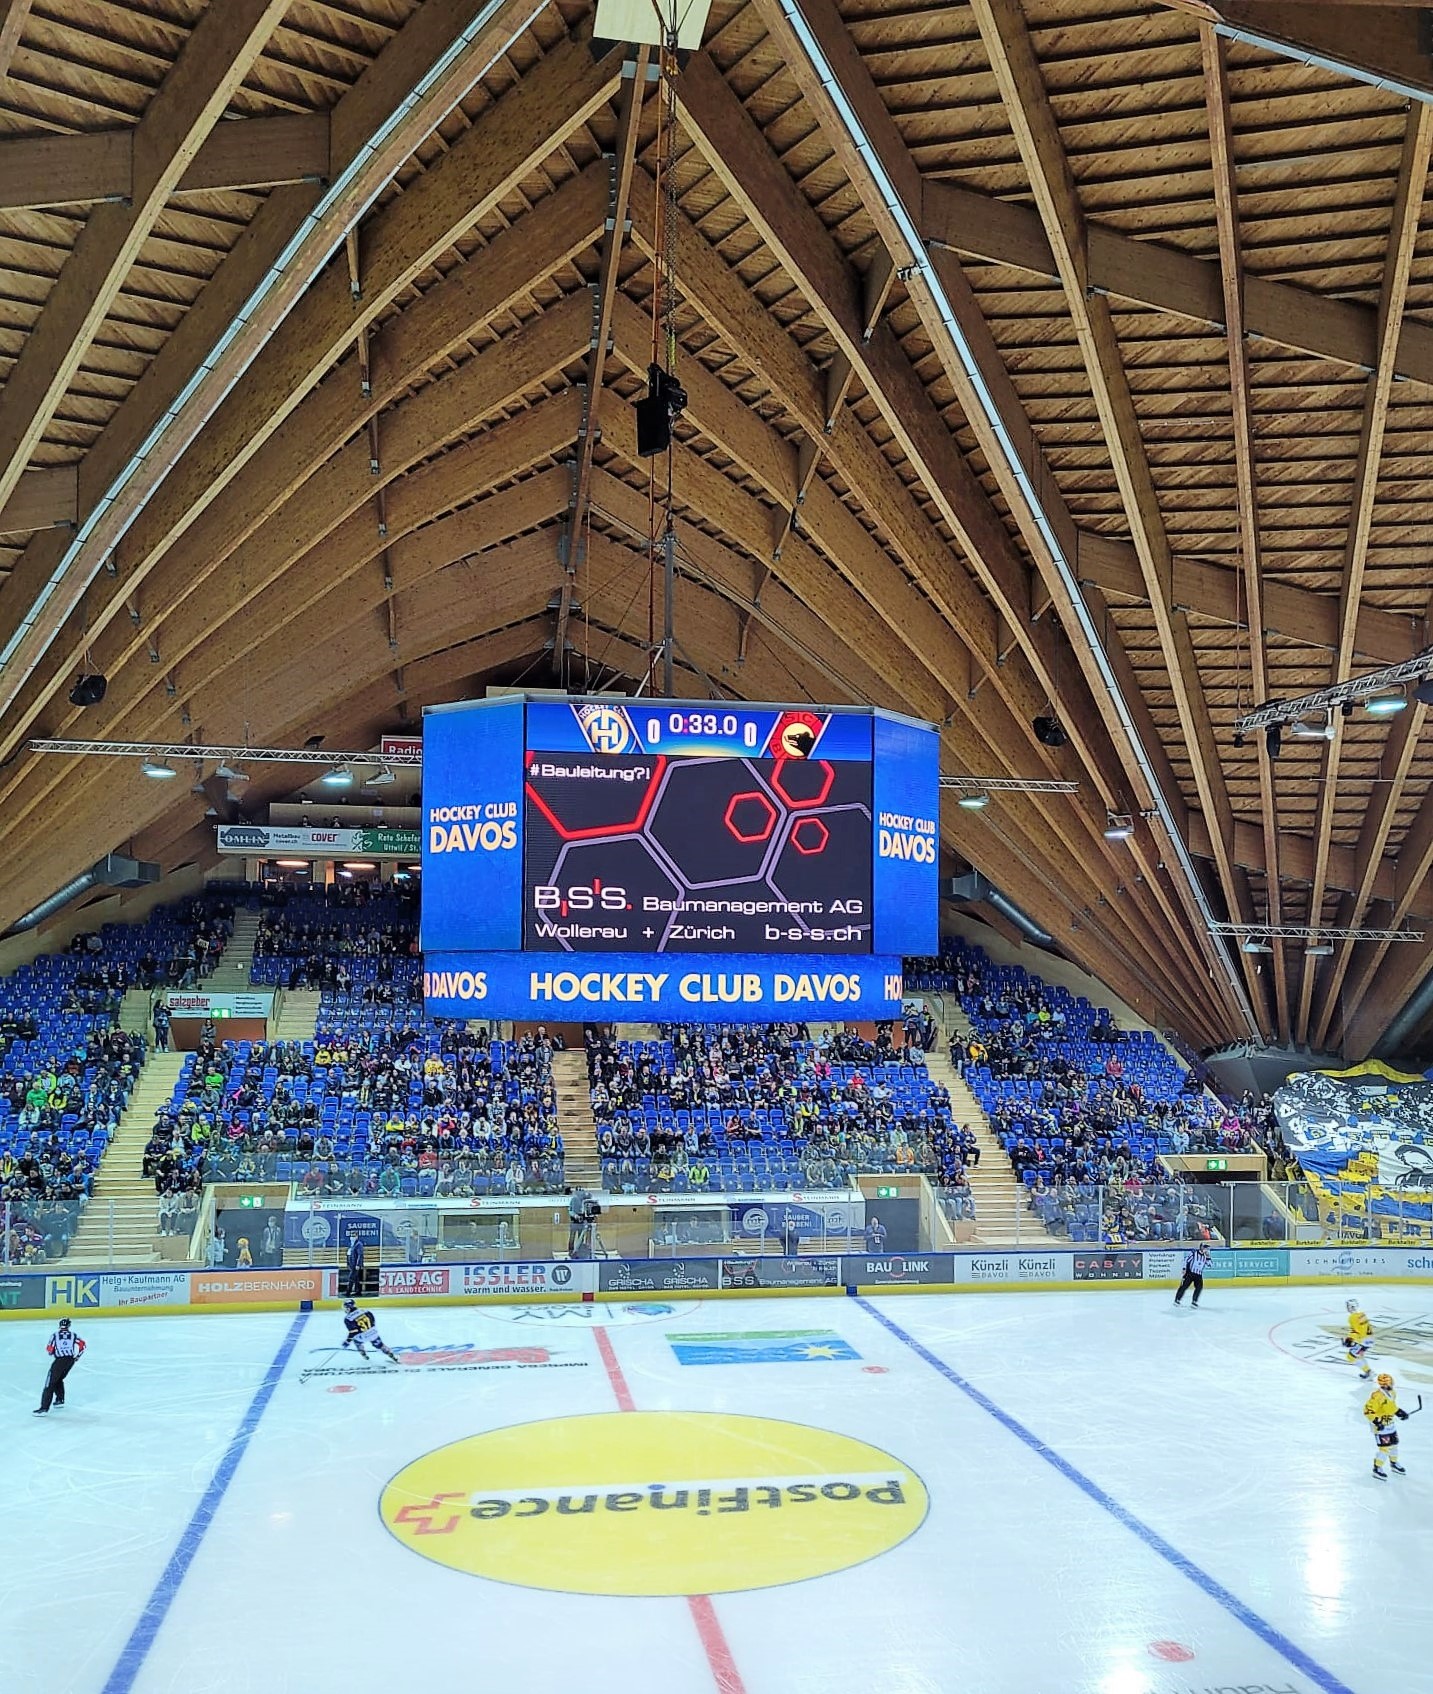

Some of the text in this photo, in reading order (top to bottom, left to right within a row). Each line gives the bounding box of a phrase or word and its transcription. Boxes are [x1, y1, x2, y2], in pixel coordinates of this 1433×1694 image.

[647, 718, 660, 743] 0
[668, 713, 738, 736] 0:33.0
[743, 721, 757, 747] 0
[430, 802, 517, 822] HOCKEY CLUB
[879, 811, 935, 834] HOCKEY CLUB
[430, 820, 518, 854] DAVOS
[879, 830, 935, 863] DAVOS
[643, 897, 863, 916] Baumanagement AG
[534, 923, 862, 941] Wollerau + Zürich b-s-s.ch
[432, 971, 487, 1000] DAVOS
[530, 971, 861, 1002] HOCKEY CLUB DAVOS
[169, 995, 210, 1008] salzgeber
[971, 1259, 1008, 1271] Künzli
[1019, 1258, 1055, 1270] Künzli
[1075, 1260, 1141, 1269] CASTY
[128, 1275, 171, 1284] Kaufmann
[174, 1274, 186, 1283] AG
[420, 1271, 443, 1286] AG
[464, 1265, 546, 1285] ISSLER
[51, 1279, 98, 1304] HK
[198, 1280, 315, 1293] HOLZBERNHARD
[464, 1286, 490, 1294] warm
[493, 1285, 510, 1293] und
[130, 1291, 168, 1304] Baupartner
[470, 1480, 906, 1519] PostFinance
